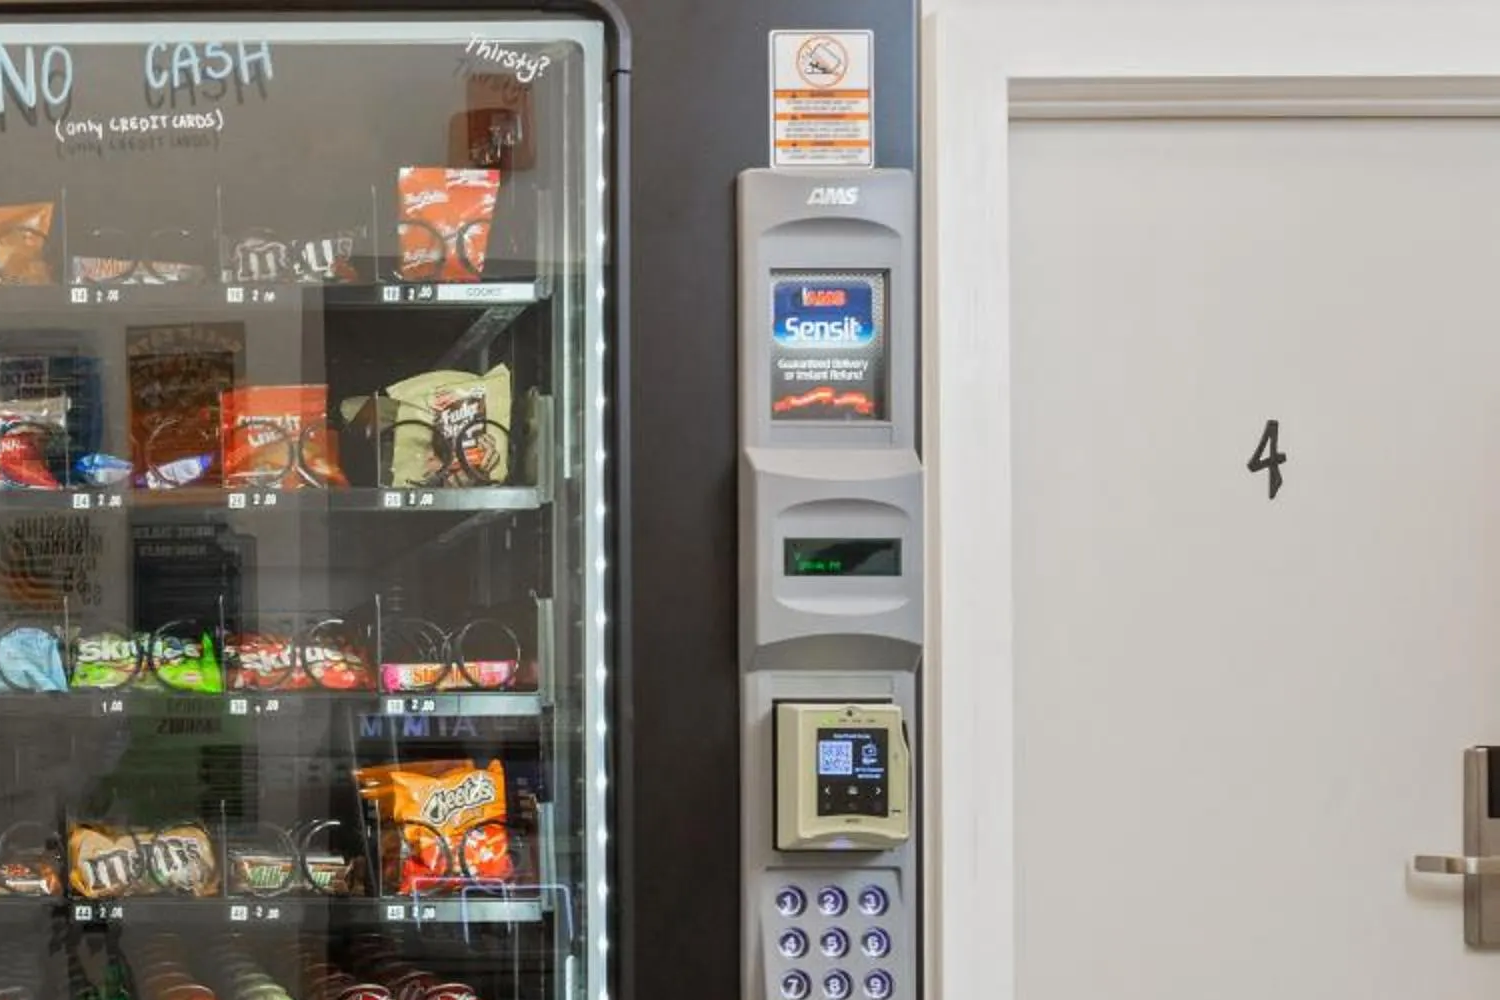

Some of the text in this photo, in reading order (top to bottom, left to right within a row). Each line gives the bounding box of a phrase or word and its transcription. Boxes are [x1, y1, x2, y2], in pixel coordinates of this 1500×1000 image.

[145, 39, 273, 89] CASH
[465, 32, 550, 82] Thirsty?
[55, 119, 103, 143] (only
[806, 186, 859, 205] AMS
[785, 316, 862, 342] Sensit
[1246, 419, 1287, 500] 4
